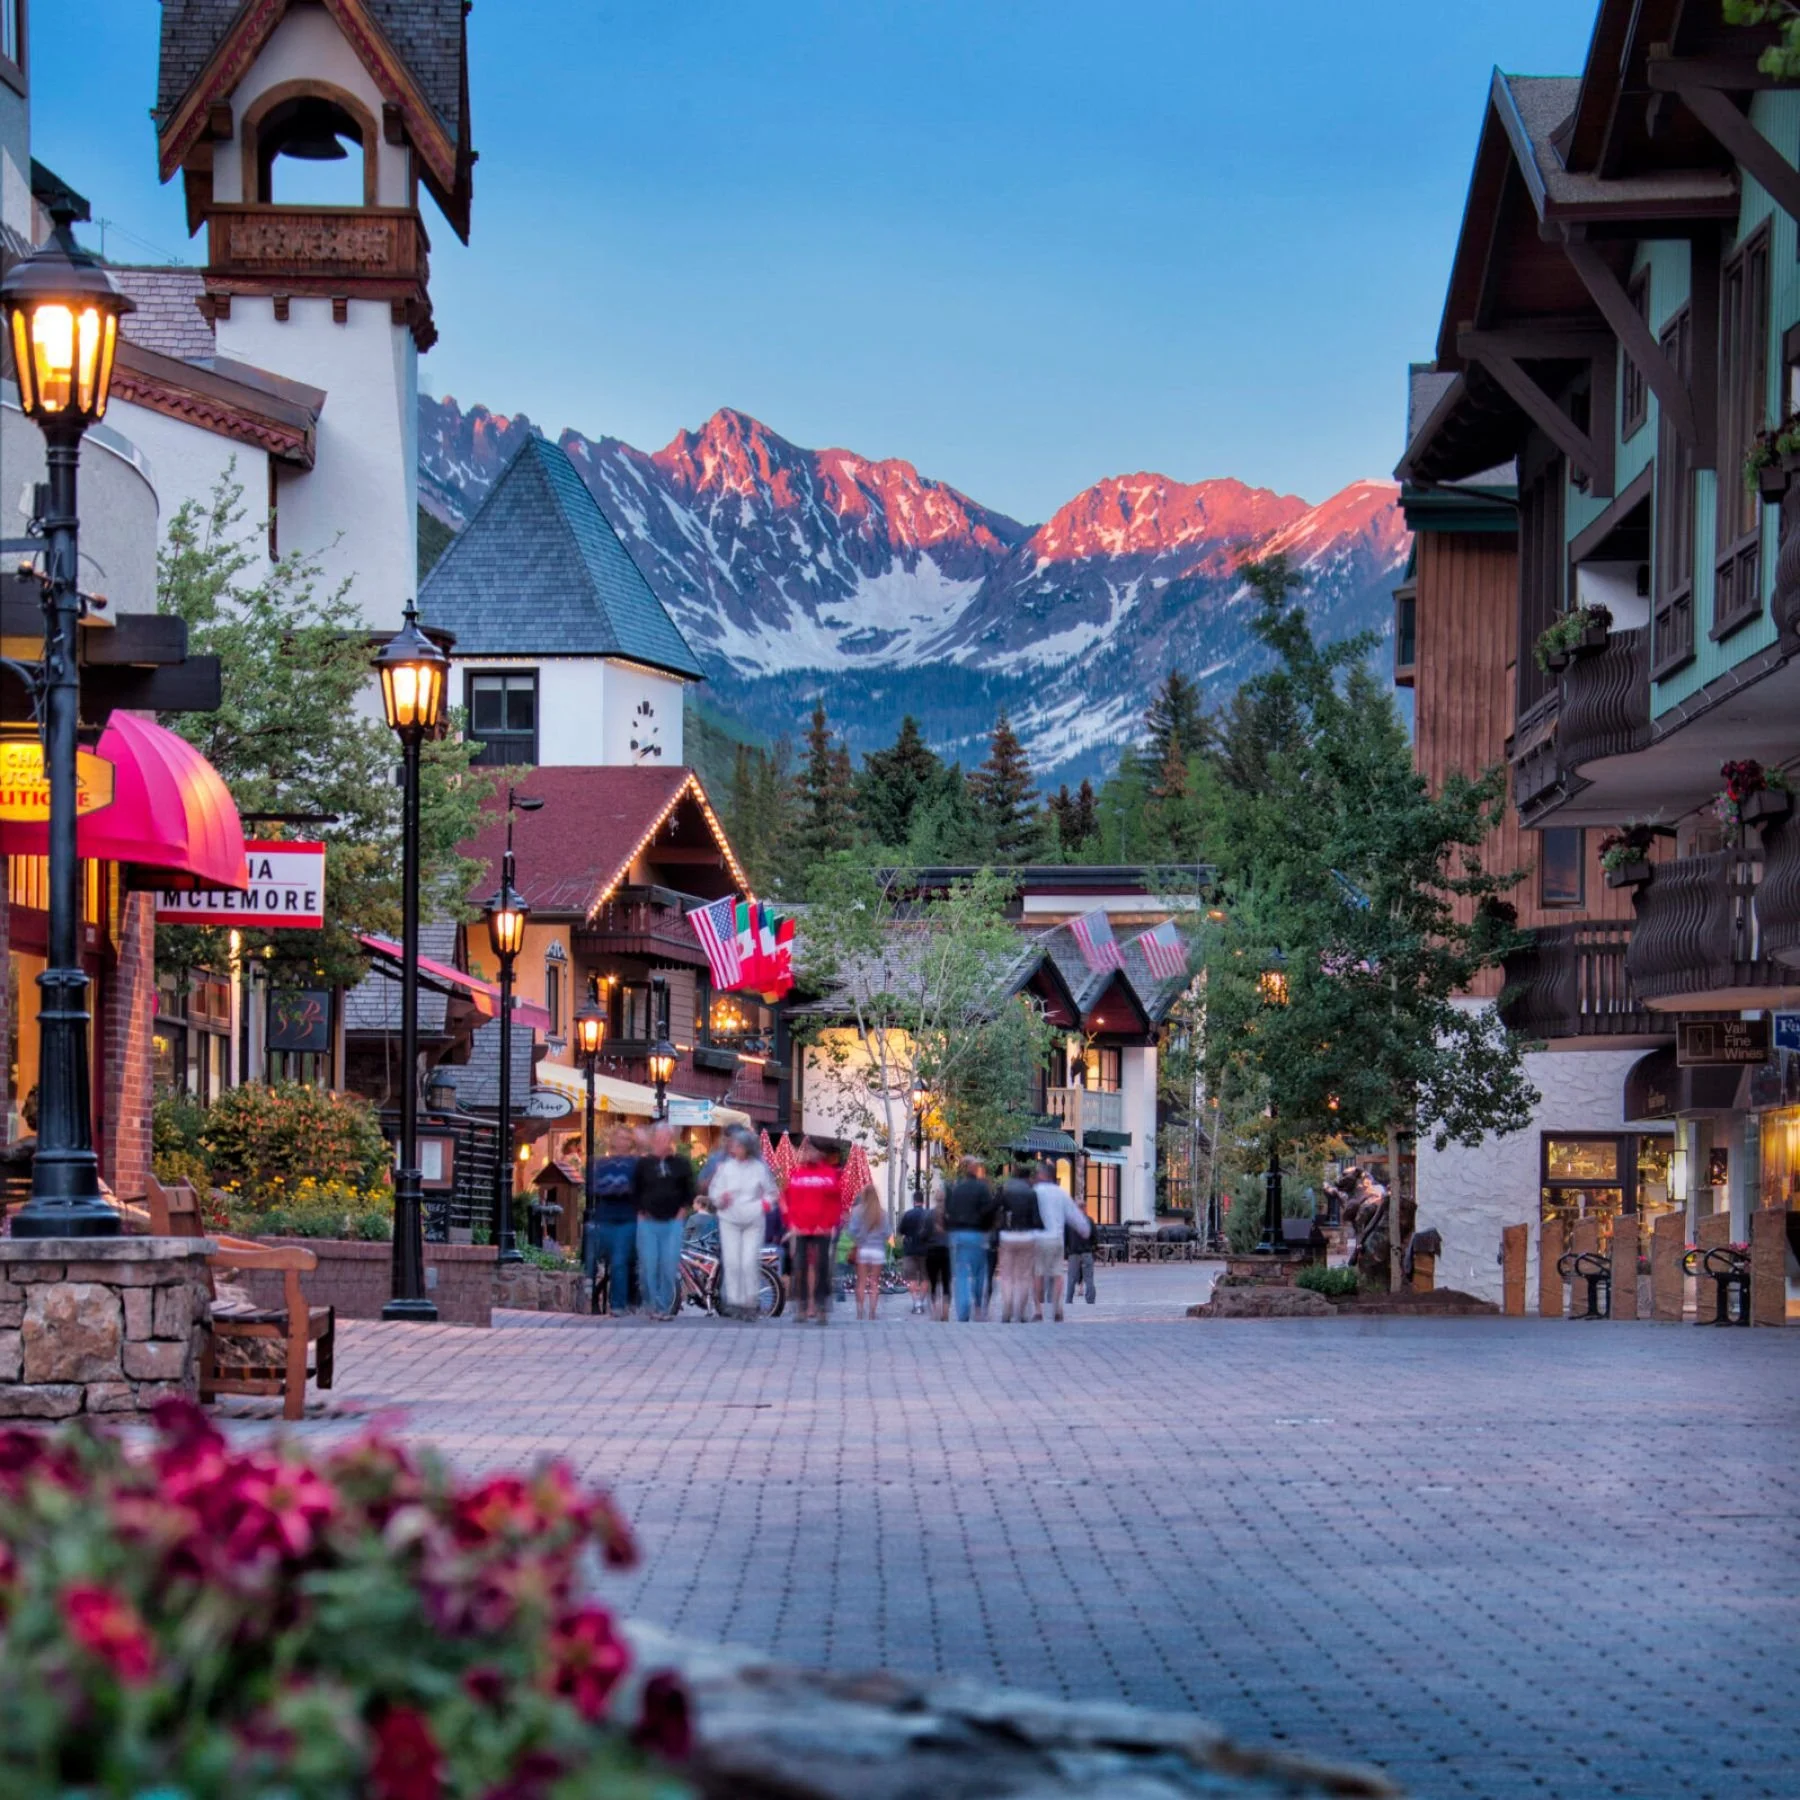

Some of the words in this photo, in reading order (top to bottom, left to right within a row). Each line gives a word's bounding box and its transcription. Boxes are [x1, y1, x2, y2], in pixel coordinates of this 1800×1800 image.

[163, 888, 317, 912] MCLEMORE
[1723, 1022, 1747, 1034] Vail
[1724, 1035, 1752, 1047] Fine
[1724, 1047, 1764, 1060] Wines
